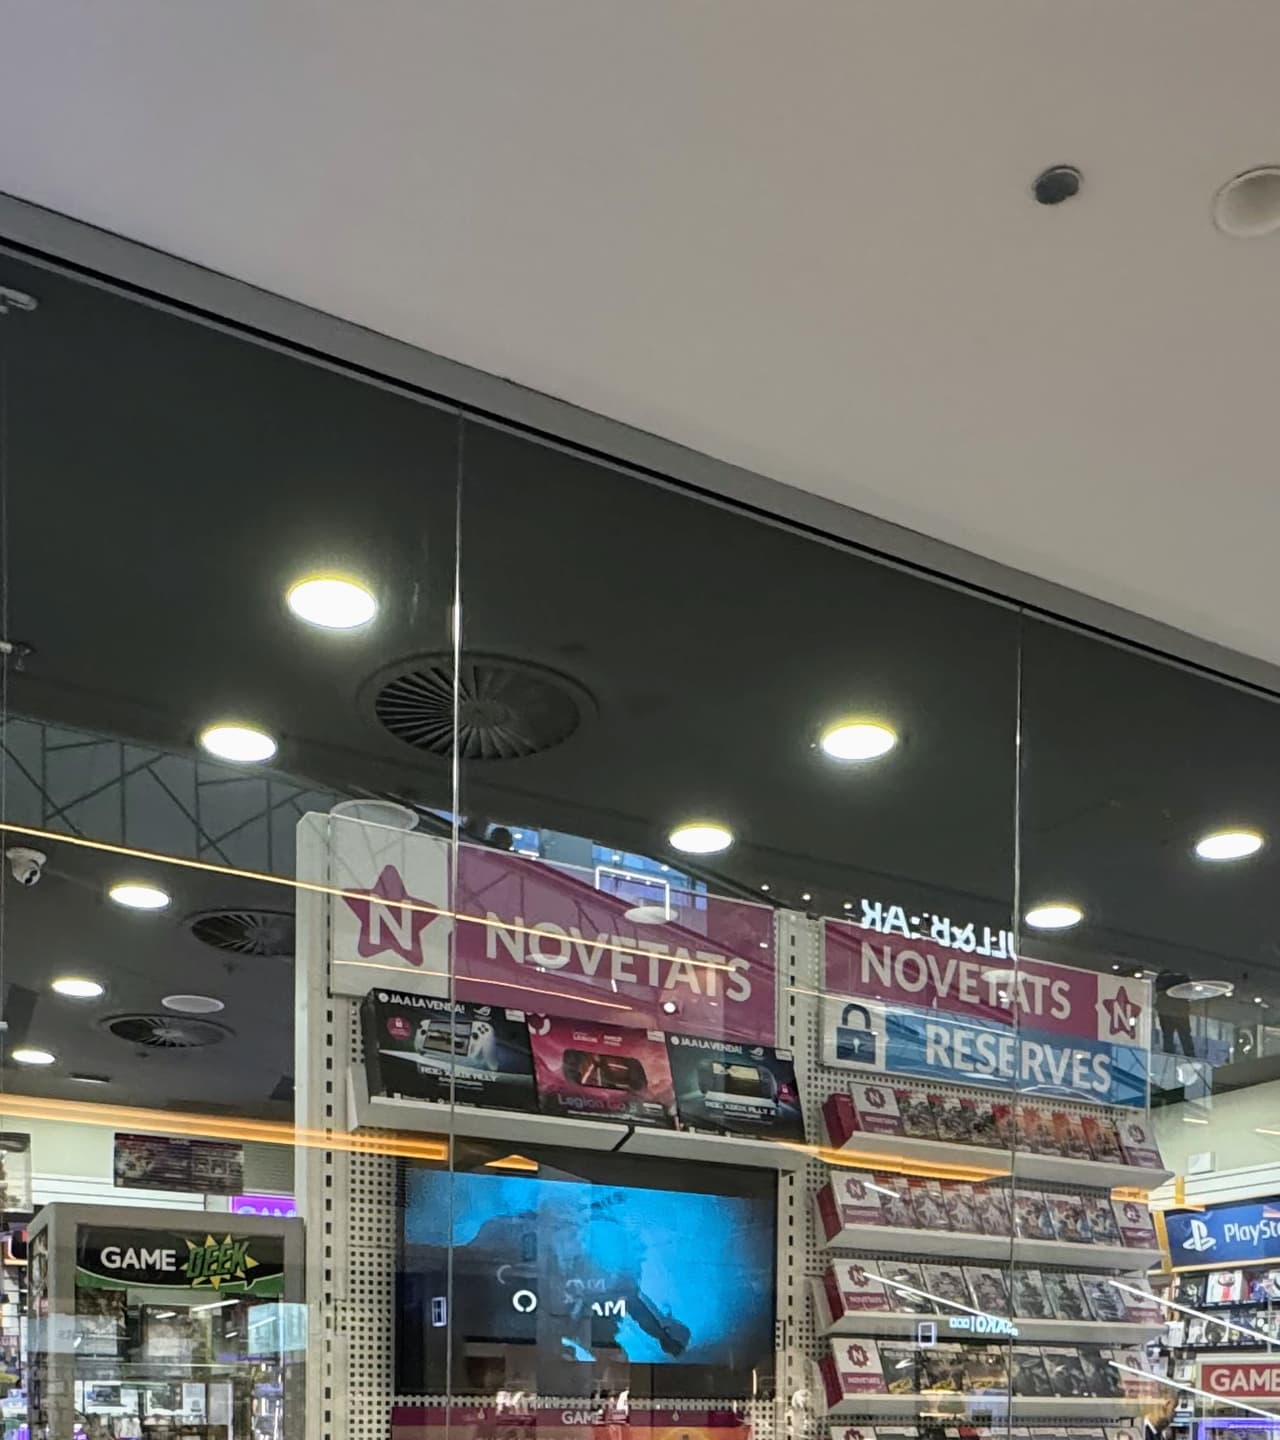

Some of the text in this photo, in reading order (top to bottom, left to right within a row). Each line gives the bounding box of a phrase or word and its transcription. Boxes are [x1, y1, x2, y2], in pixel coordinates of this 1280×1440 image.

[486, 913, 752, 1002] NOVETATS
[860, 942, 1071, 1021] NOVETATS
[426, 1000, 466, 1014] VENDA!
[925, 1024, 1112, 1093] RESERVES
[100, 1240, 249, 1279] GAME GEEK
[562, 1411, 604, 1425] GAME
